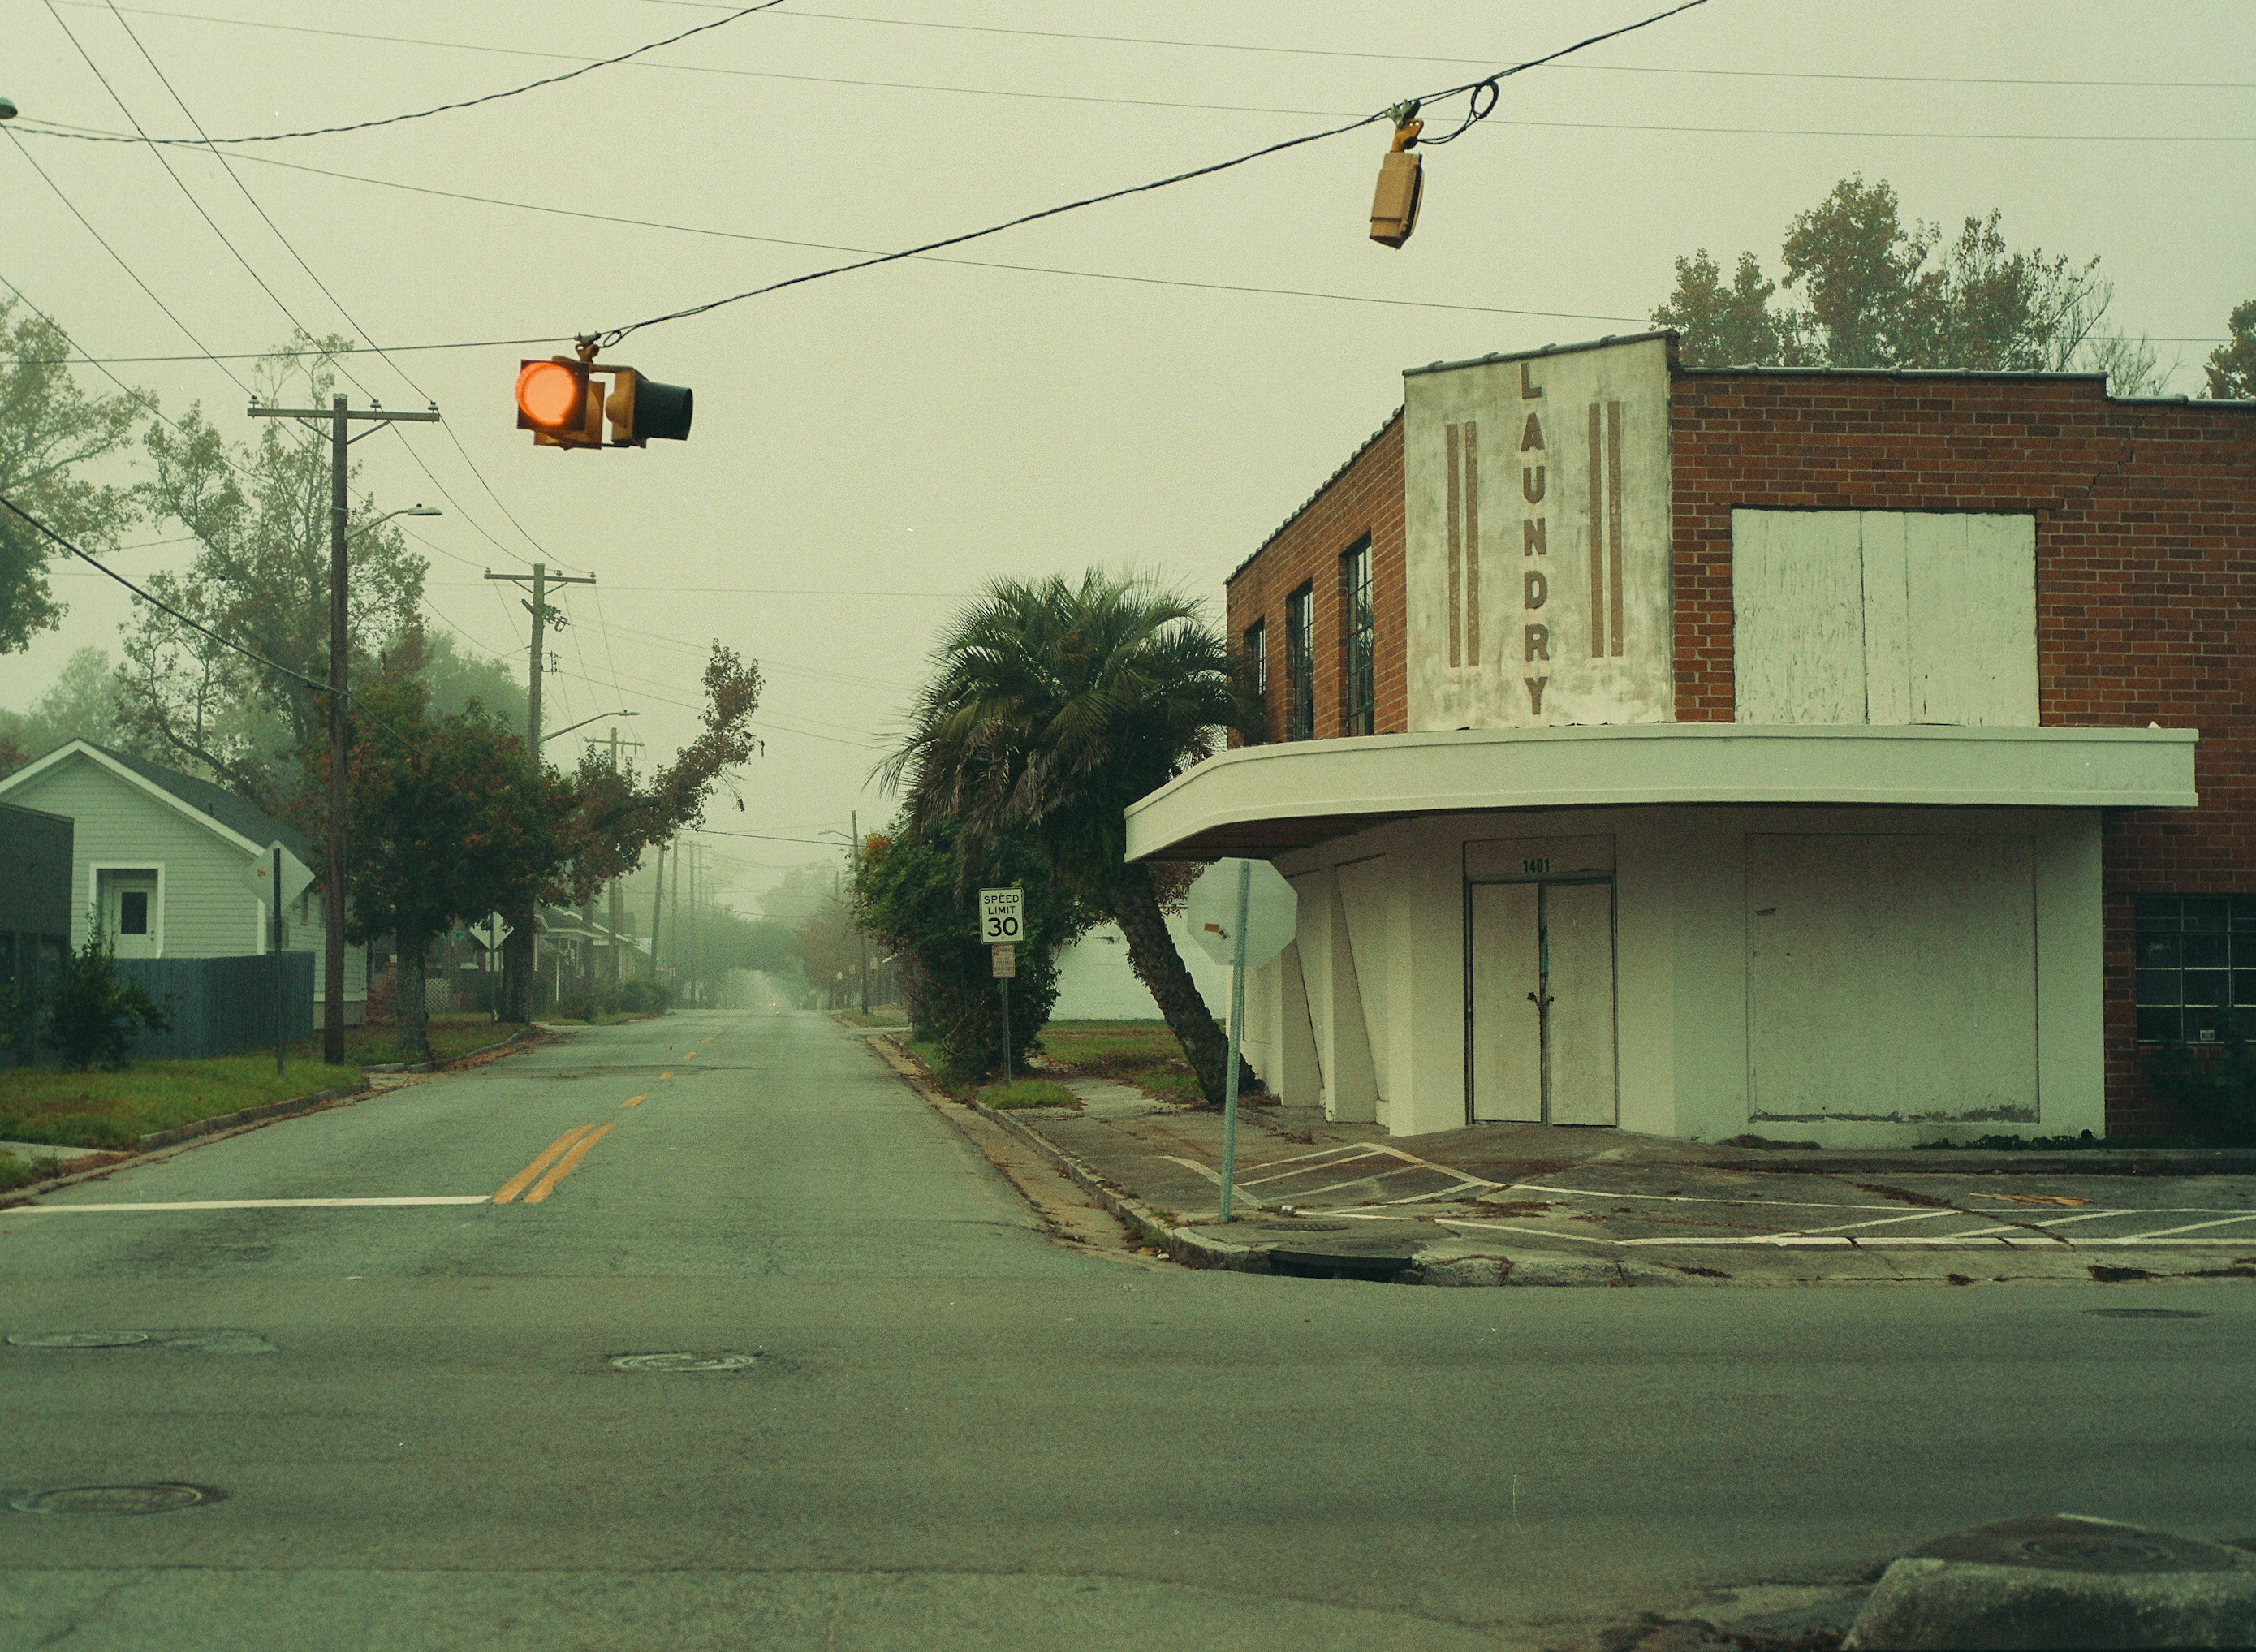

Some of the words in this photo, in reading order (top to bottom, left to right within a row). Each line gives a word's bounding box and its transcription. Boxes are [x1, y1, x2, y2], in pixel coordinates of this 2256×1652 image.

[1521, 363, 1550, 715] LAUNDRY
[1523, 858, 1550, 873] 1401
[984, 895, 1020, 904] SPEED
[988, 906, 1016, 915] LIMIT
[987, 917, 1019, 937] 30
